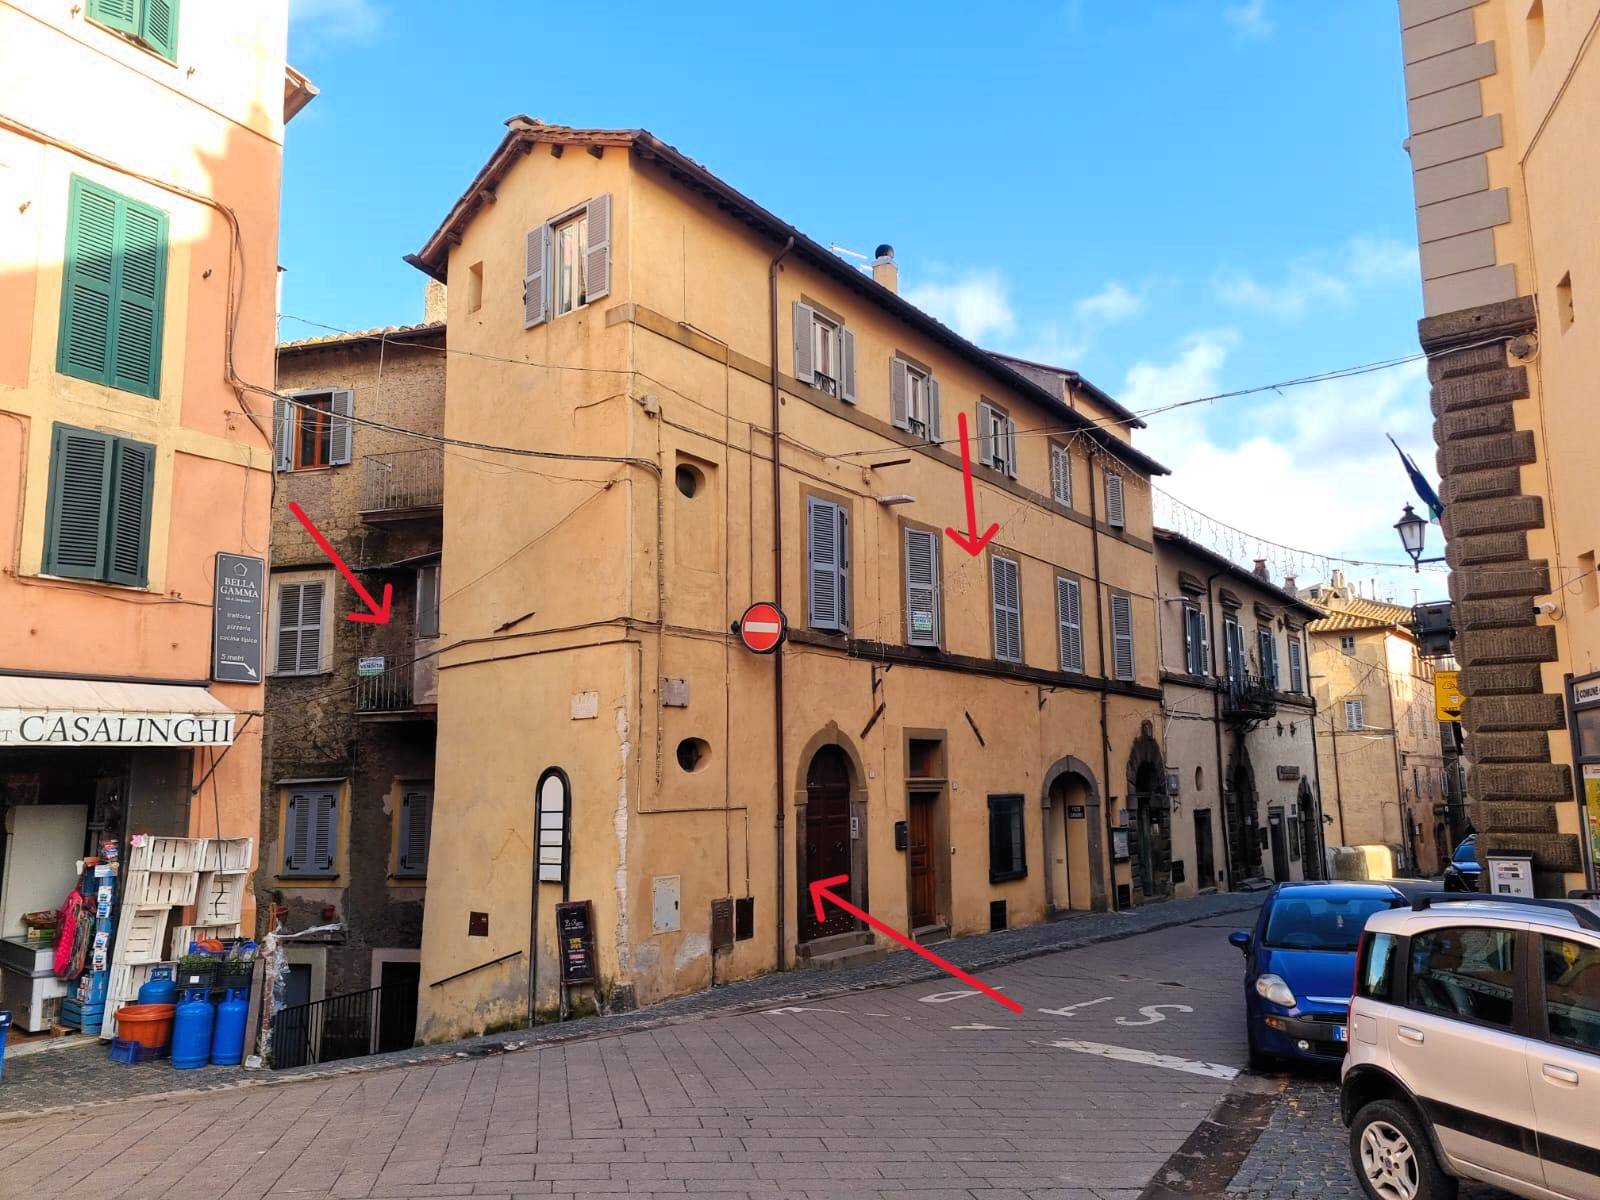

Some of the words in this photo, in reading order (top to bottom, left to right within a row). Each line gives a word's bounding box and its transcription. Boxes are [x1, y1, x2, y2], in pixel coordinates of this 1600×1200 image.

[224, 577, 256, 589] BELLA
[220, 586, 260, 599] GAMMA
[1579, 686, 1599, 699] COMUNE
[19, 715, 231, 742] CASALINGHI
